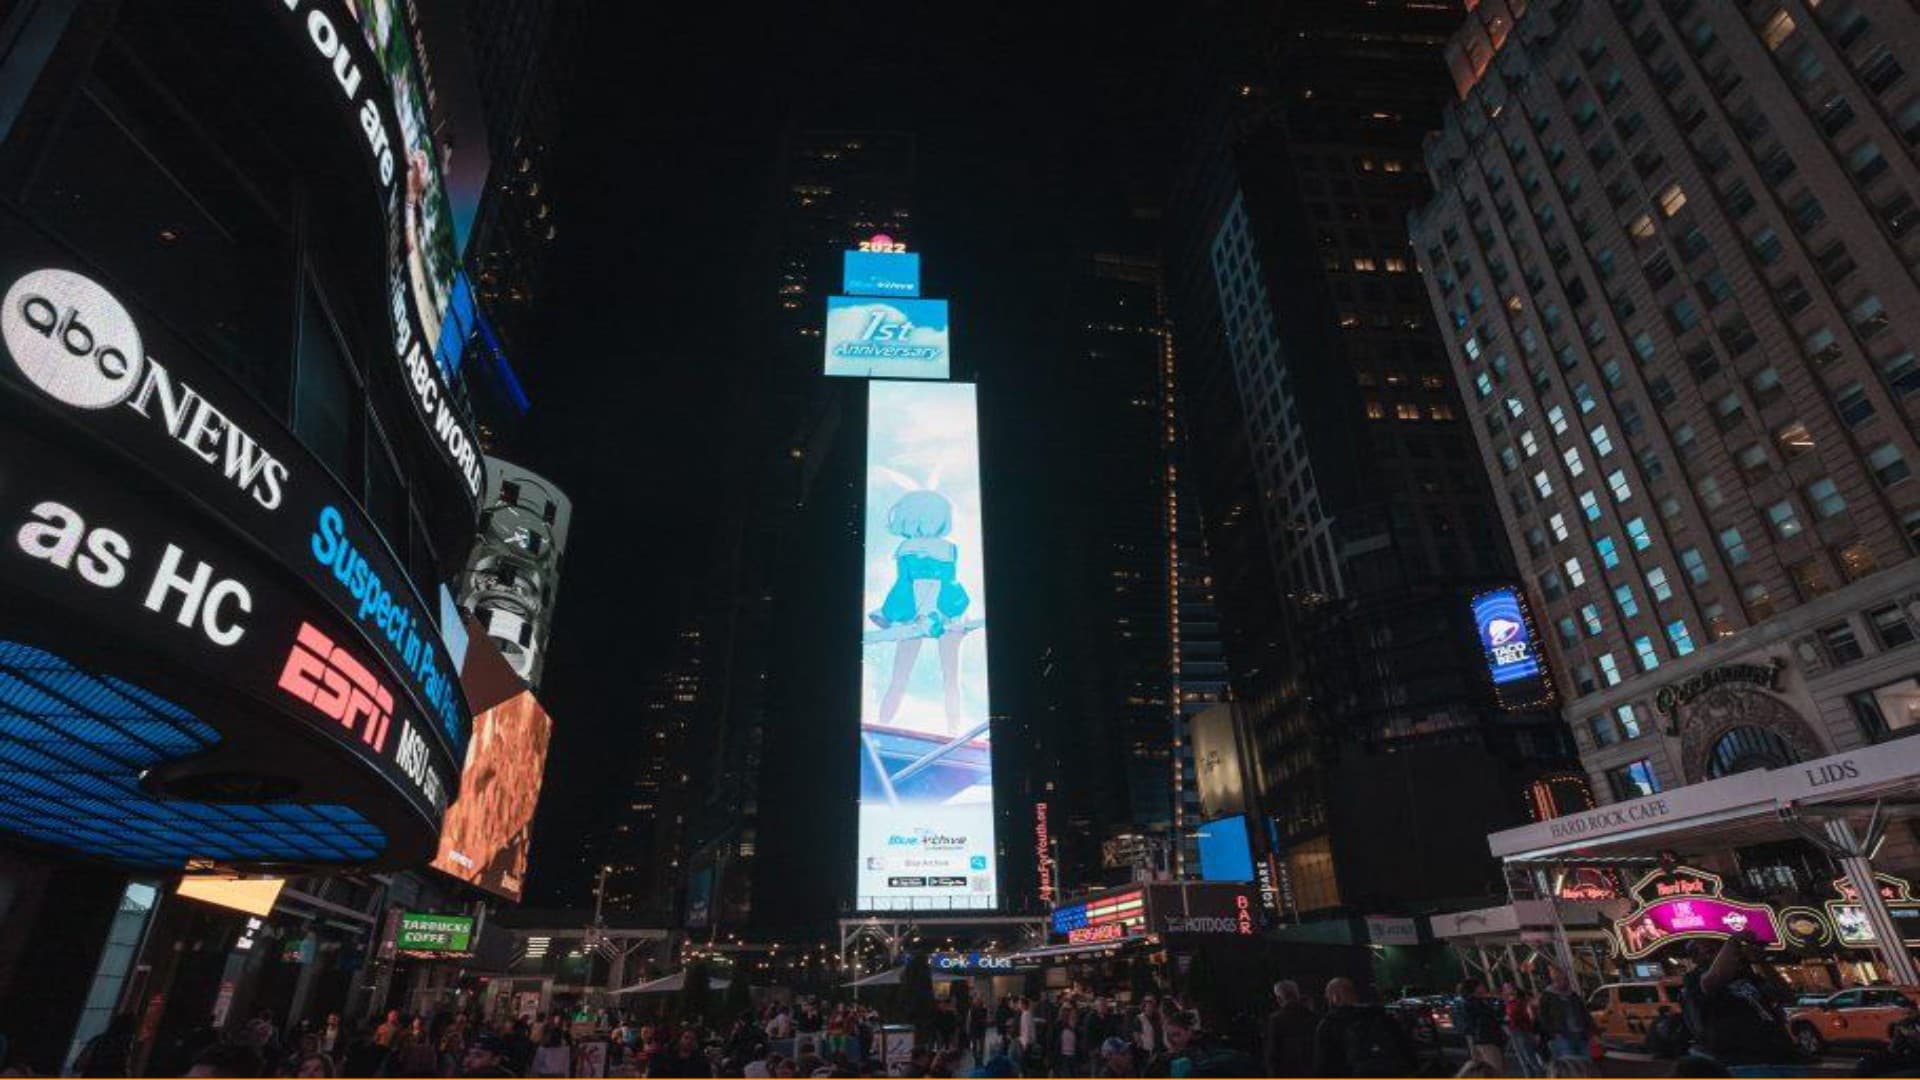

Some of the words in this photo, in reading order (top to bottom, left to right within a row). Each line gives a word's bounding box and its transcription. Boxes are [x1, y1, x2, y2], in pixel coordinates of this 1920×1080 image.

[283, 0, 361, 100] ou
[360, 99, 394, 187] are
[858, 241, 907, 254] 2022
[23, 297, 128, 380] abc
[862, 311, 914, 341] 1st
[834, 343, 942, 361] Anniversary
[406, 341, 438, 413] ABC
[127, 356, 289, 511] NEWS
[17, 500, 131, 589] as
[144, 543, 253, 647] HC
[311, 505, 409, 651] Suspect
[403, 617, 421, 673] in
[1491, 641, 1526, 658] TACO
[1497, 651, 1531, 666] BELL
[278, 620, 394, 753] ESPN
[395, 718, 429, 787] MSU
[1805, 760, 1860, 787] LIDS
[1551, 820, 1587, 839] HARD
[1589, 812, 1625, 832] ROCK
[1629, 800, 1670, 824] CAFE
[888, 835, 918, 845] Blue
[1237, 895, 1252, 935] BAR
